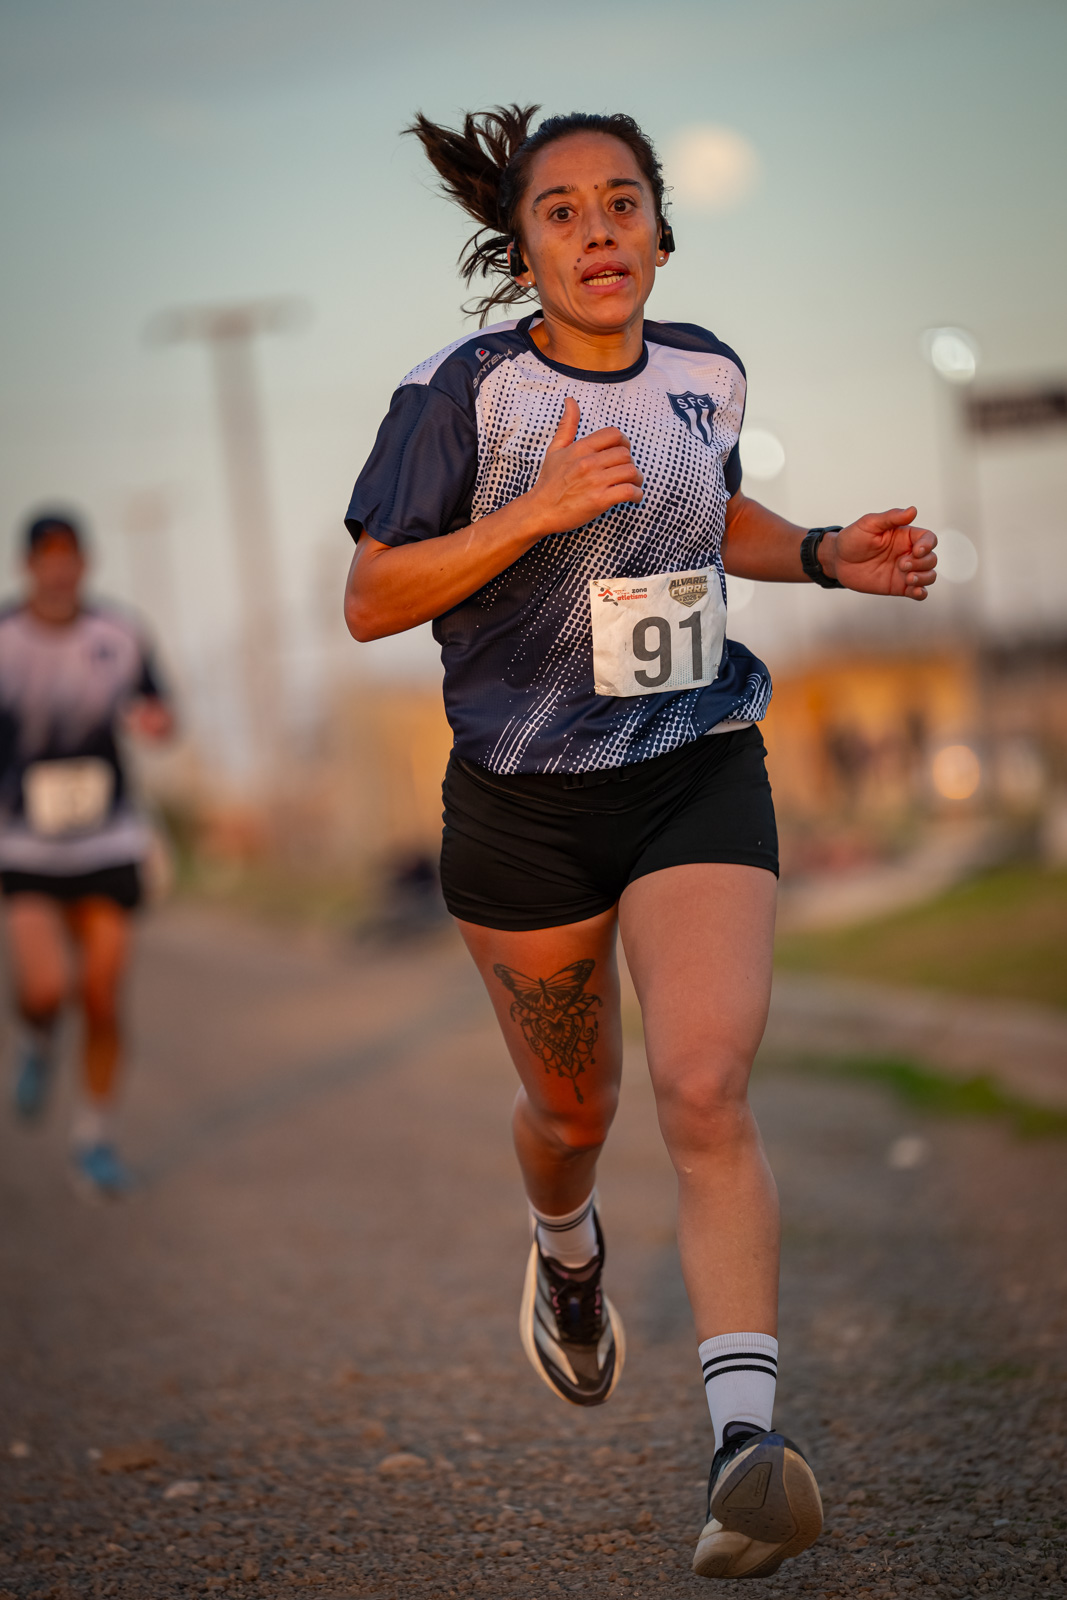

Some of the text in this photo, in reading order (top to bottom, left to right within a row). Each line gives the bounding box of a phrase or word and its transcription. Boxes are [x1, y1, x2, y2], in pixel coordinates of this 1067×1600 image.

[676, 397, 708, 409] SFC
[669, 575, 708, 589] ALVAREZ
[671, 584, 708, 596] CORRE
[617, 593, 648, 601] atletismo
[632, 611, 703, 688] 91
